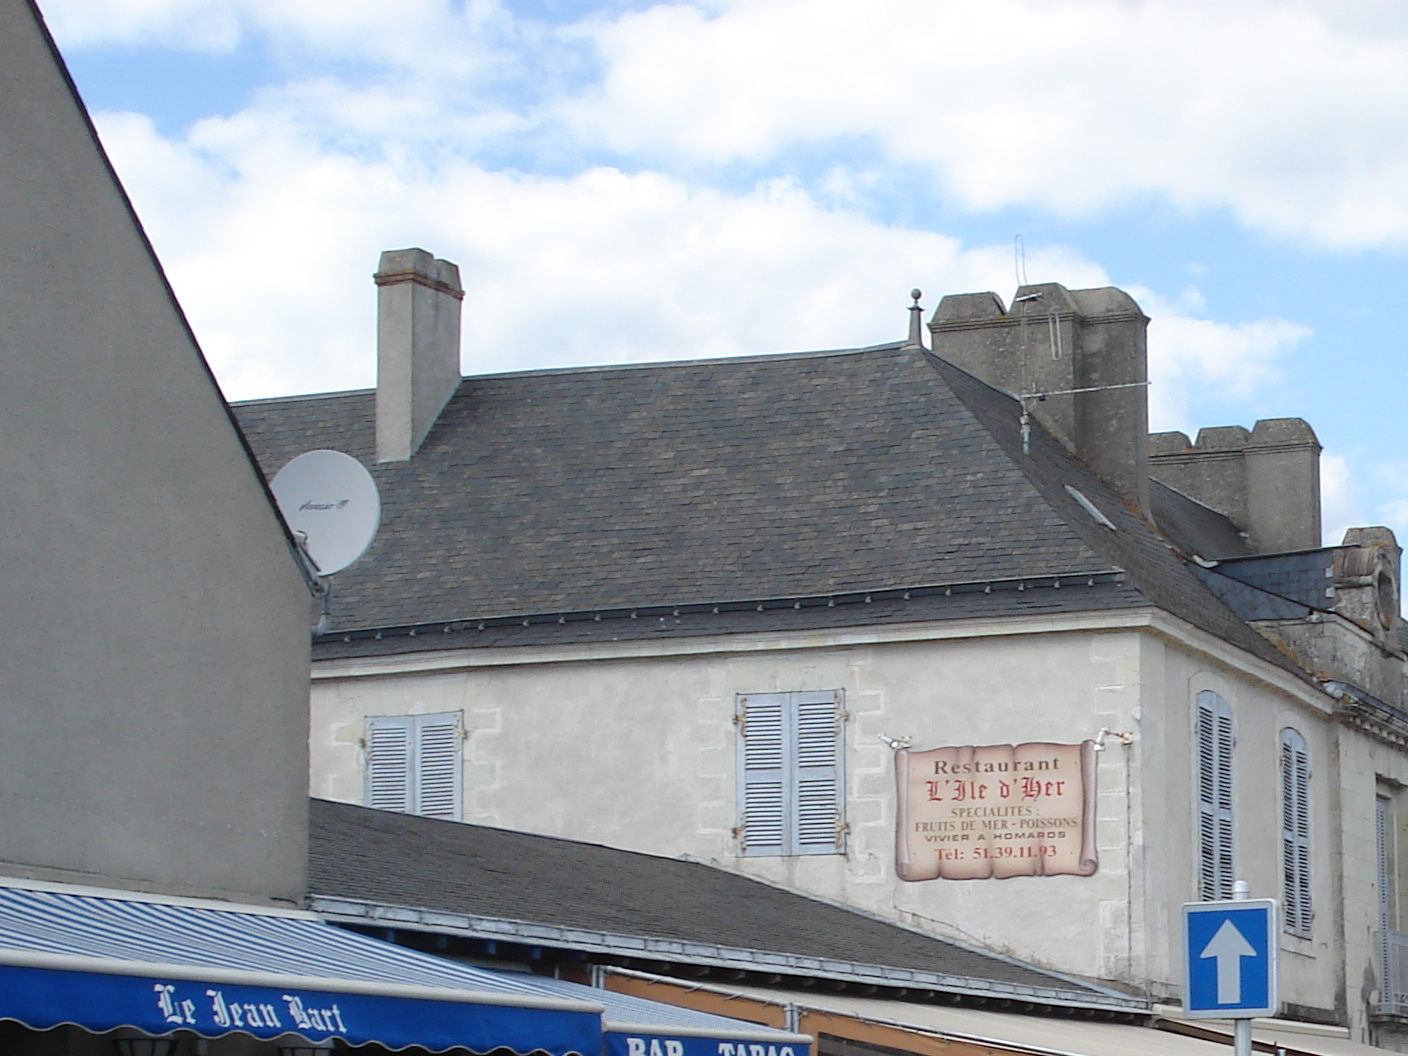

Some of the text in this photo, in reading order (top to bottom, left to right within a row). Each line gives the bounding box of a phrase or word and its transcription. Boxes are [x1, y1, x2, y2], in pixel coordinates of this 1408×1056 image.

[934, 757, 1060, 775] Restaurant
[925, 776, 1065, 802] L'Ile d'Her
[951, 805, 1032, 818] SPECIALITES
[915, 821, 956, 832] FRUITS
[961, 820, 976, 831] DE
[982, 819, 1008, 831] MER
[1020, 817, 1078, 829] POISSONS
[924, 831, 1066, 842] VIVIER A HOMARDS
[934, 845, 1057, 860] Tél: 51.39.11.93
[154, 983, 347, 1033] Le Jean Bart
